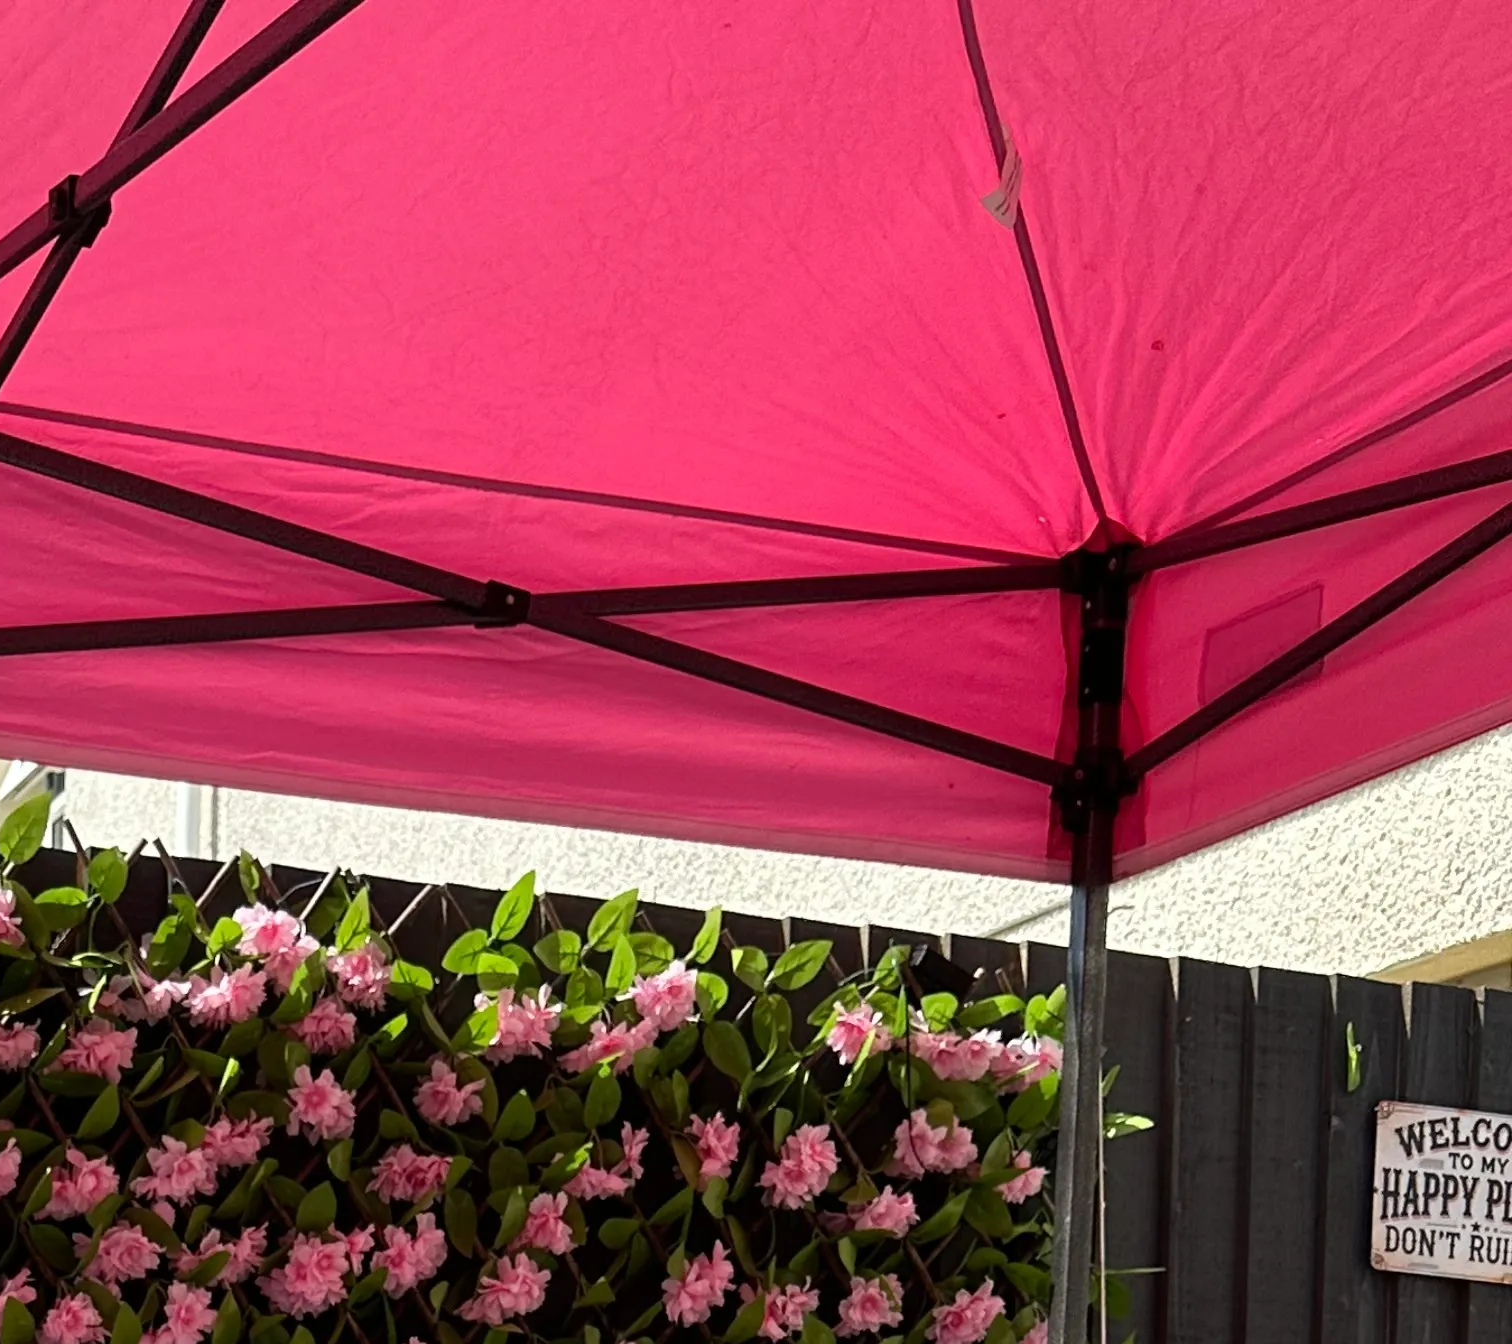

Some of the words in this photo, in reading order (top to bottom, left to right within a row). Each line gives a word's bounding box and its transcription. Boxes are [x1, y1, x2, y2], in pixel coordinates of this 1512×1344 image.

[1448, 1152, 1473, 1170] TO
[1481, 1156, 1509, 1175] MY
[1380, 1168, 1480, 1220] HAPPY
[1384, 1225, 1461, 1259] DON'T
[1468, 1234, 1512, 1266] RUI
